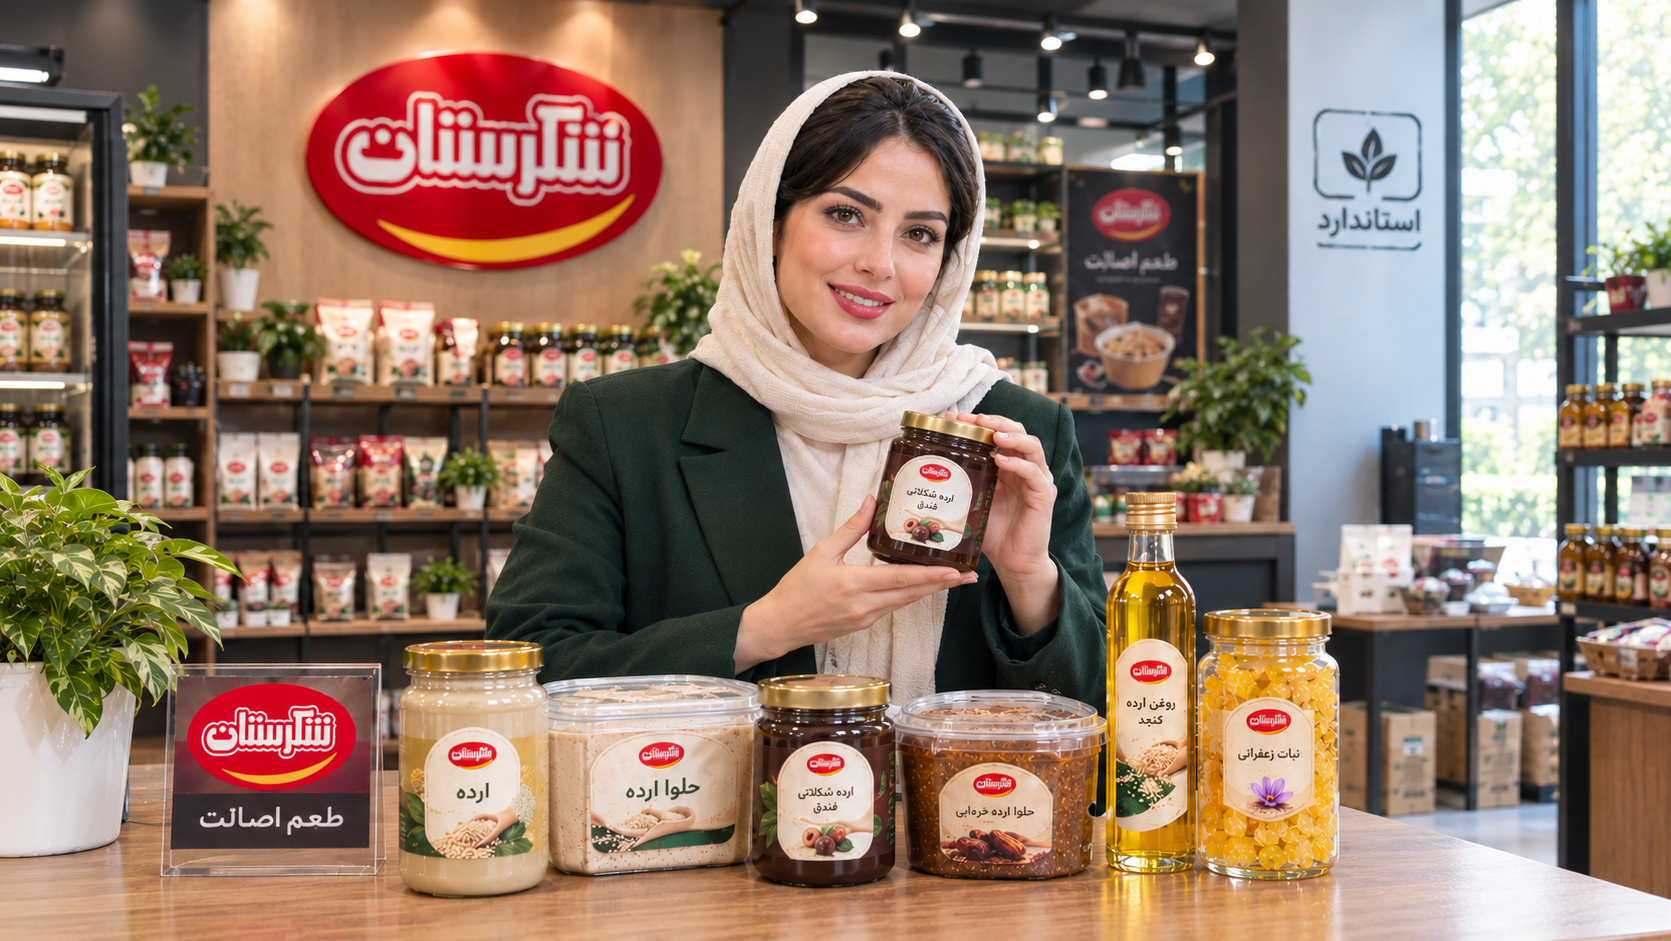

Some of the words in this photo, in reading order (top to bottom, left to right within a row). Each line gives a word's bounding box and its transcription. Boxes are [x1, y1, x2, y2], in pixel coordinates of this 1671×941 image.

[336, 92, 631, 205] شکرستان
[1318, 206, 1421, 238] استاندارد
[1139, 250, 1179, 276] طعم
[938, 494, 955, 504] ارده
[1126, 697, 1146, 711] ارده
[1149, 698, 1176, 711] روغن
[1138, 715, 1163, 727] کنجد
[201, 705, 337, 759] شکرستان
[1237, 747, 1275, 761] زعفرانی
[1277, 748, 1300, 761] نبات
[456, 782, 490, 804] ارده
[626, 780, 658, 802] ارده
[664, 777, 700, 801] حلوا
[836, 786, 854, 799] ارده
[813, 802, 838, 814] فندق
[991, 806, 1010, 819] ارده
[1014, 805, 1035, 819] حلوا
[286, 806, 344, 836] طعم
